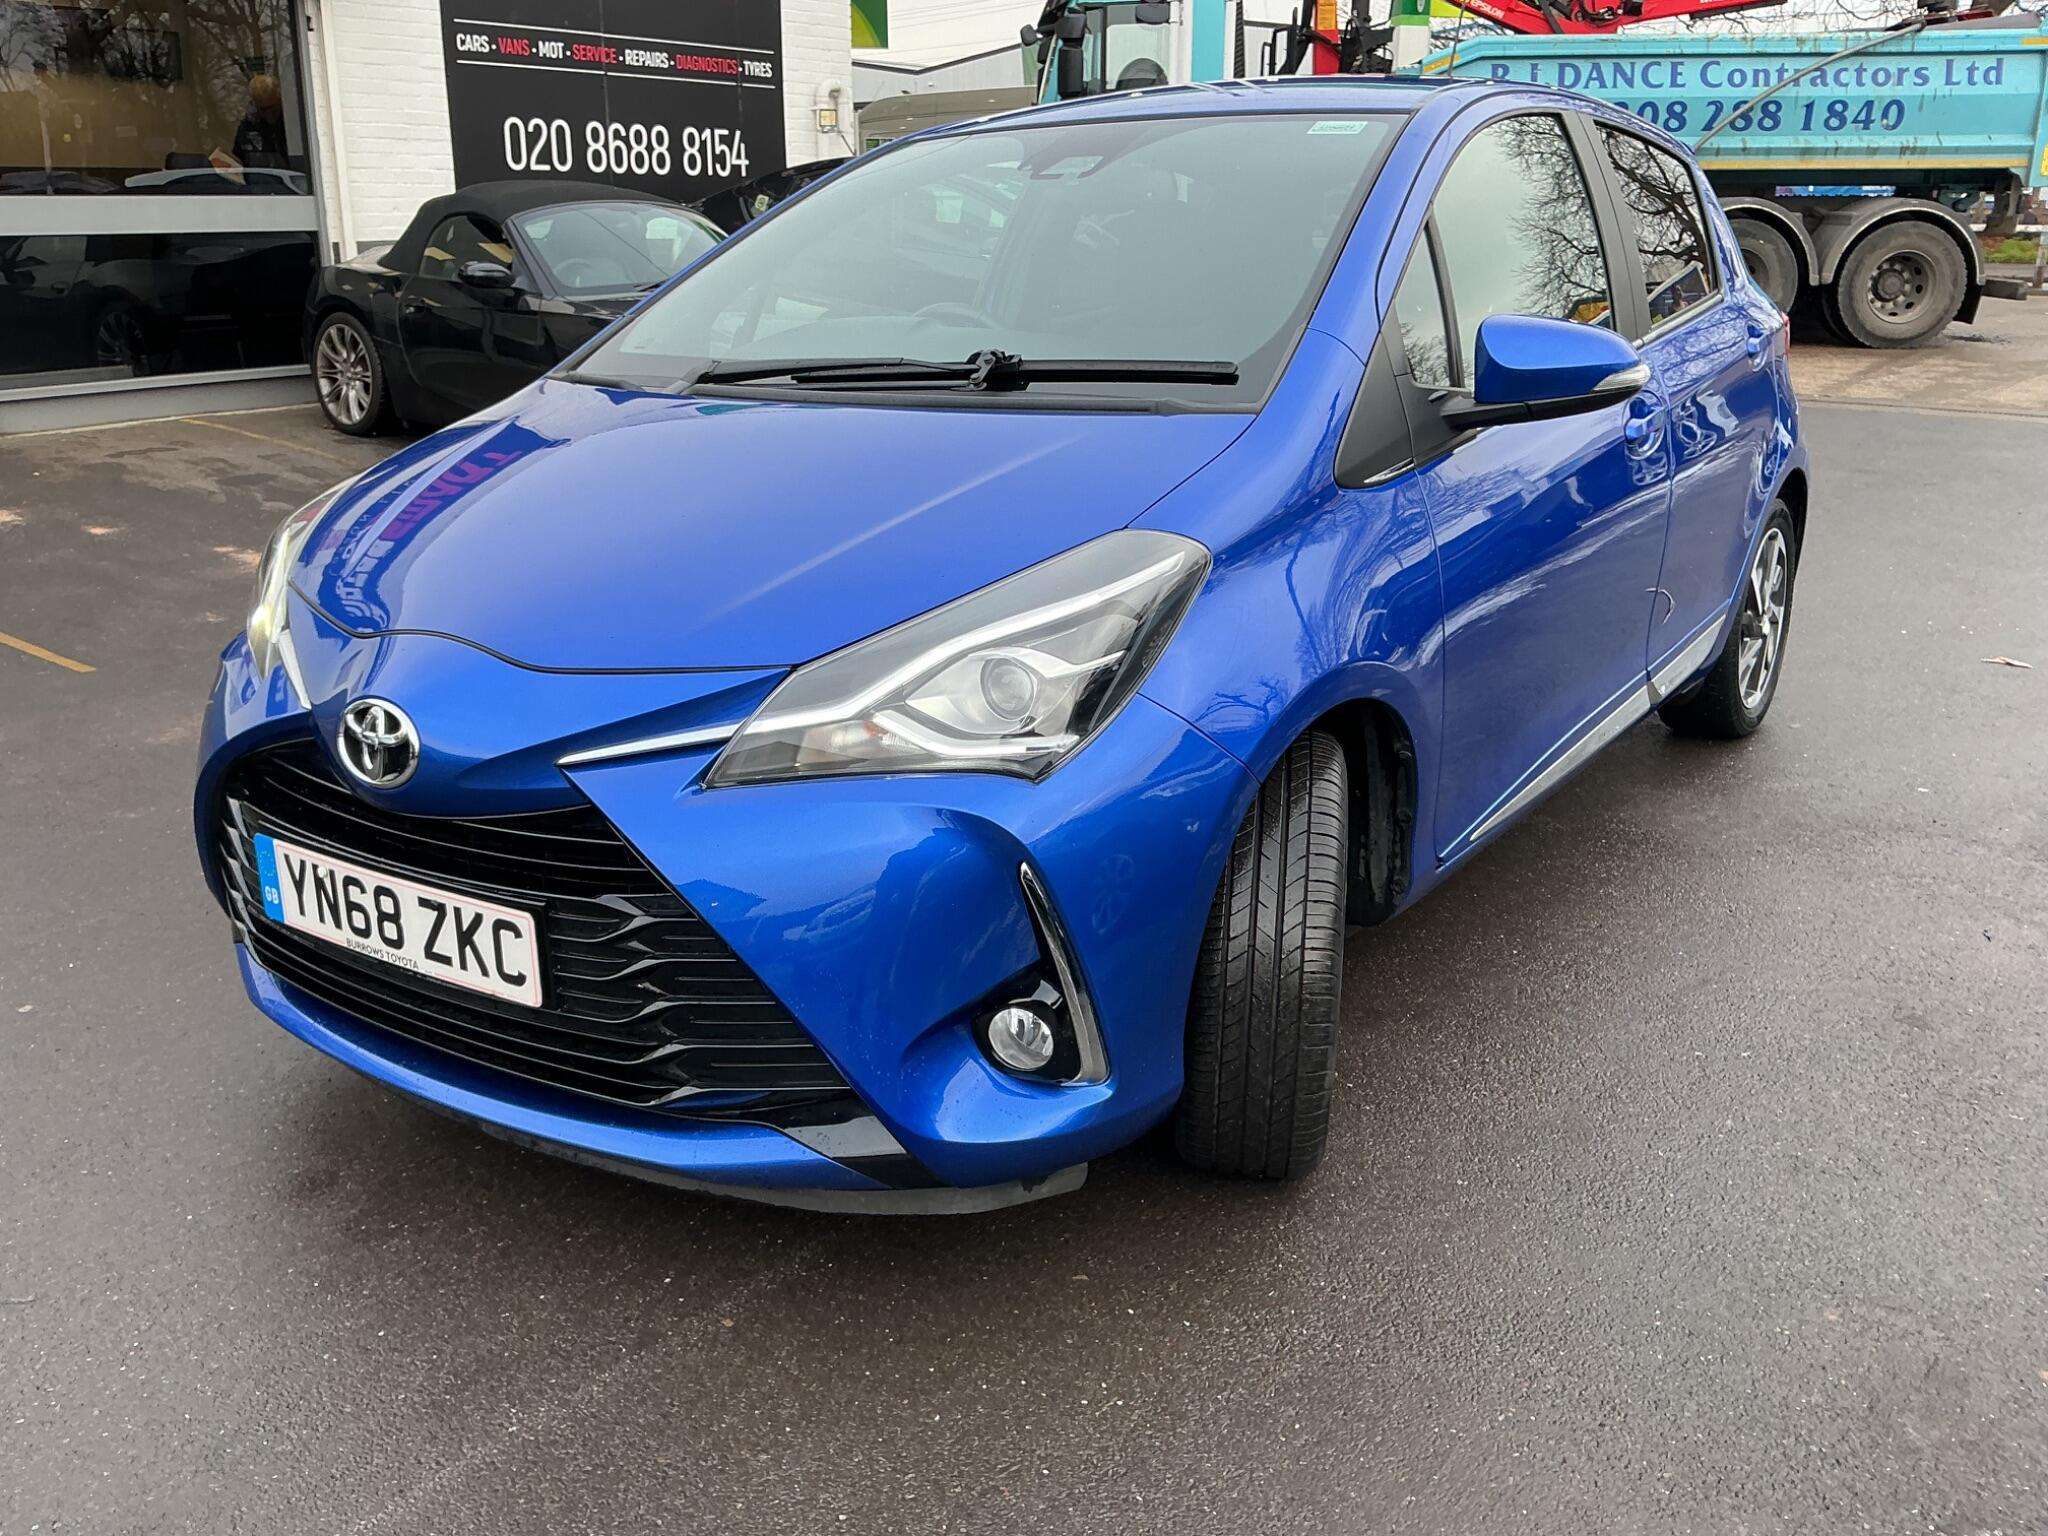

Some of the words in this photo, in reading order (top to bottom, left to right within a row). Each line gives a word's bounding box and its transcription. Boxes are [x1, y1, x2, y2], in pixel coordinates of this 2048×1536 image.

[456, 33, 490, 53] CARS
[498, 37, 530, 56] VANS
[538, 40, 565, 59] MOT
[572, 44, 618, 64] SERVICE
[624, 49, 669, 69] REPAIRS
[675, 54, 738, 75] DIAGNOSTICS
[743, 60, 773, 78] TYRES
[1557, 60, 1687, 89] DANCE
[1944, 57, 2005, 87] Ltd
[1701, 100, 1783, 132] 288
[1801, 99, 1906, 132] 1840
[503, 116, 573, 172] 020
[585, 120, 672, 176] 8688
[682, 126, 750, 178] 8154
[265, 886, 280, 905] GB
[283, 852, 405, 951] YN68
[416, 896, 528, 988] ZKC
[346, 937, 385, 960] BURROWS
[385, 951, 420, 971] TOYOTA
